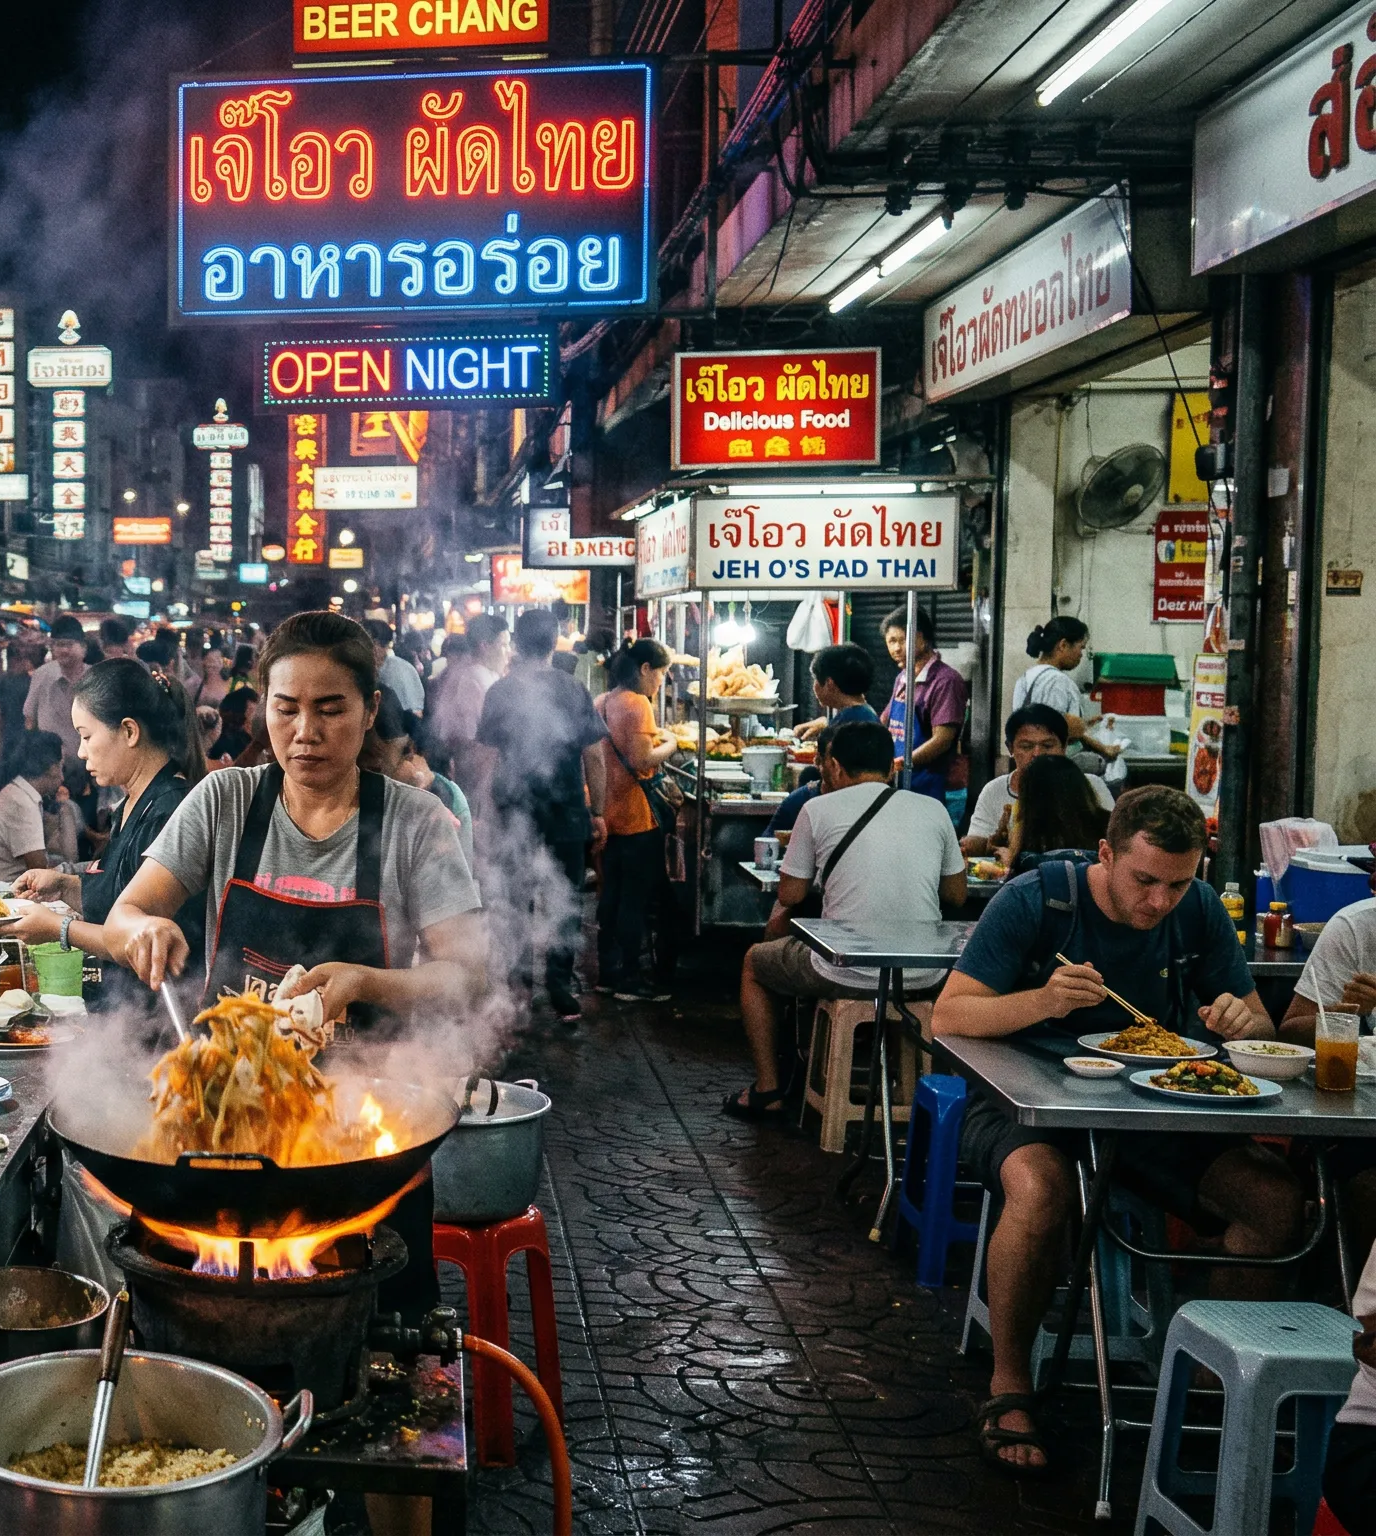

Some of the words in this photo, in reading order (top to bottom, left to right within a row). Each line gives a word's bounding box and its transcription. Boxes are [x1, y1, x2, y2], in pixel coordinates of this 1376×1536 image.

[303, 2, 399, 41] BEER
[409, 0, 538, 36] CHANG
[190, 90, 374, 203] เจ๊โอว
[405, 80, 636, 196] ผัดไทย
[202, 212, 622, 302] อาหารอร่อย
[270, 349, 391, 394] OPEN
[405, 345, 540, 390] NIGHT
[776, 359, 870, 401] ผัดไทย
[703, 410, 794, 431] Delicious
[800, 408, 850, 429] Food
[708, 505, 806, 548] เจ๊โอว
[824, 505, 943, 547] ผัดไทย
[712, 559, 760, 579] JEH
[768, 559, 810, 579] O'S
[819, 558, 869, 579] PAD
[877, 558, 936, 579] THAI
